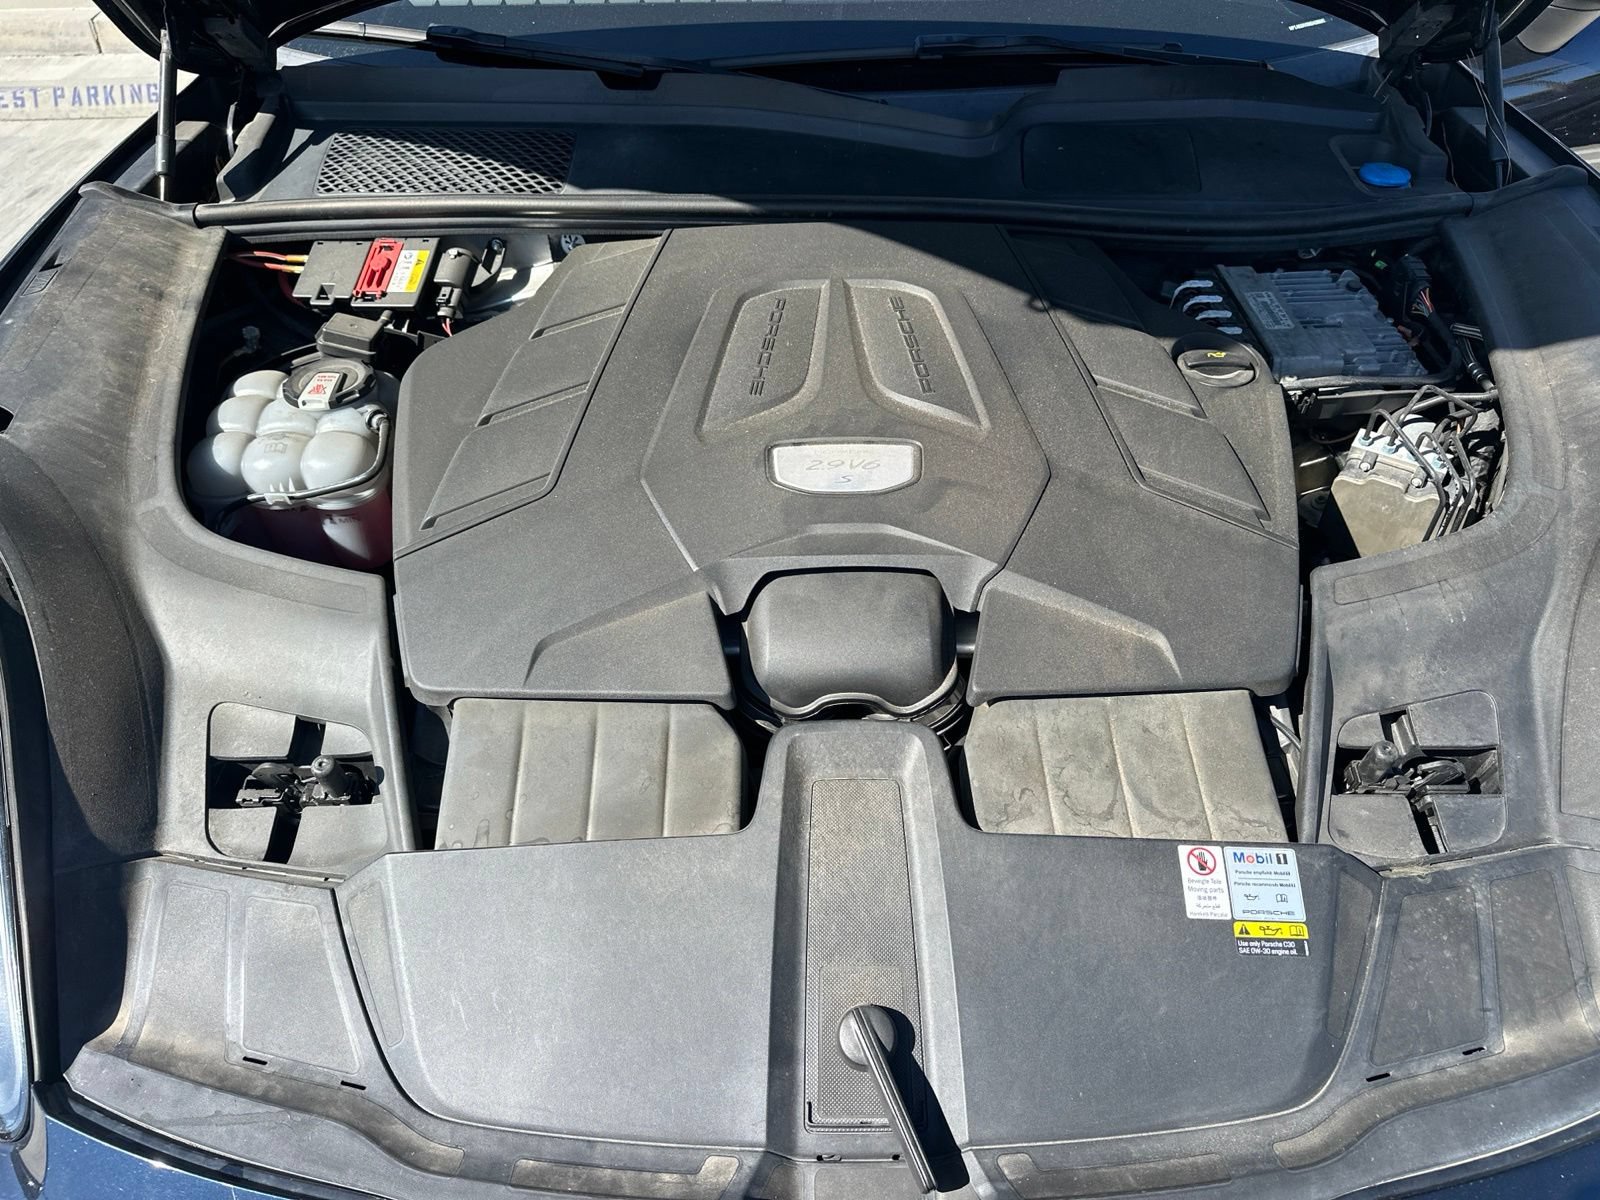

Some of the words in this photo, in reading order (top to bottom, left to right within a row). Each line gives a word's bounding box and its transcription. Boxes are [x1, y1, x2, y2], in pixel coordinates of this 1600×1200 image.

[0, 86, 39, 109] EST
[53, 83, 159, 107] PARKING
[749, 297, 787, 396] PORSCHE
[887, 296, 932, 393] PORSCHE
[834, 474, 855, 484] S
[1232, 852, 1273, 865] Mobil
[1276, 853, 1288, 865] 1
[1188, 885, 1209, 894] Moving
[1249, 940, 1260, 948] only
[1261, 940, 1282, 948] Porsche
[1250, 947, 1271, 955] 0W-30
[1271, 948, 1289, 956] engine
